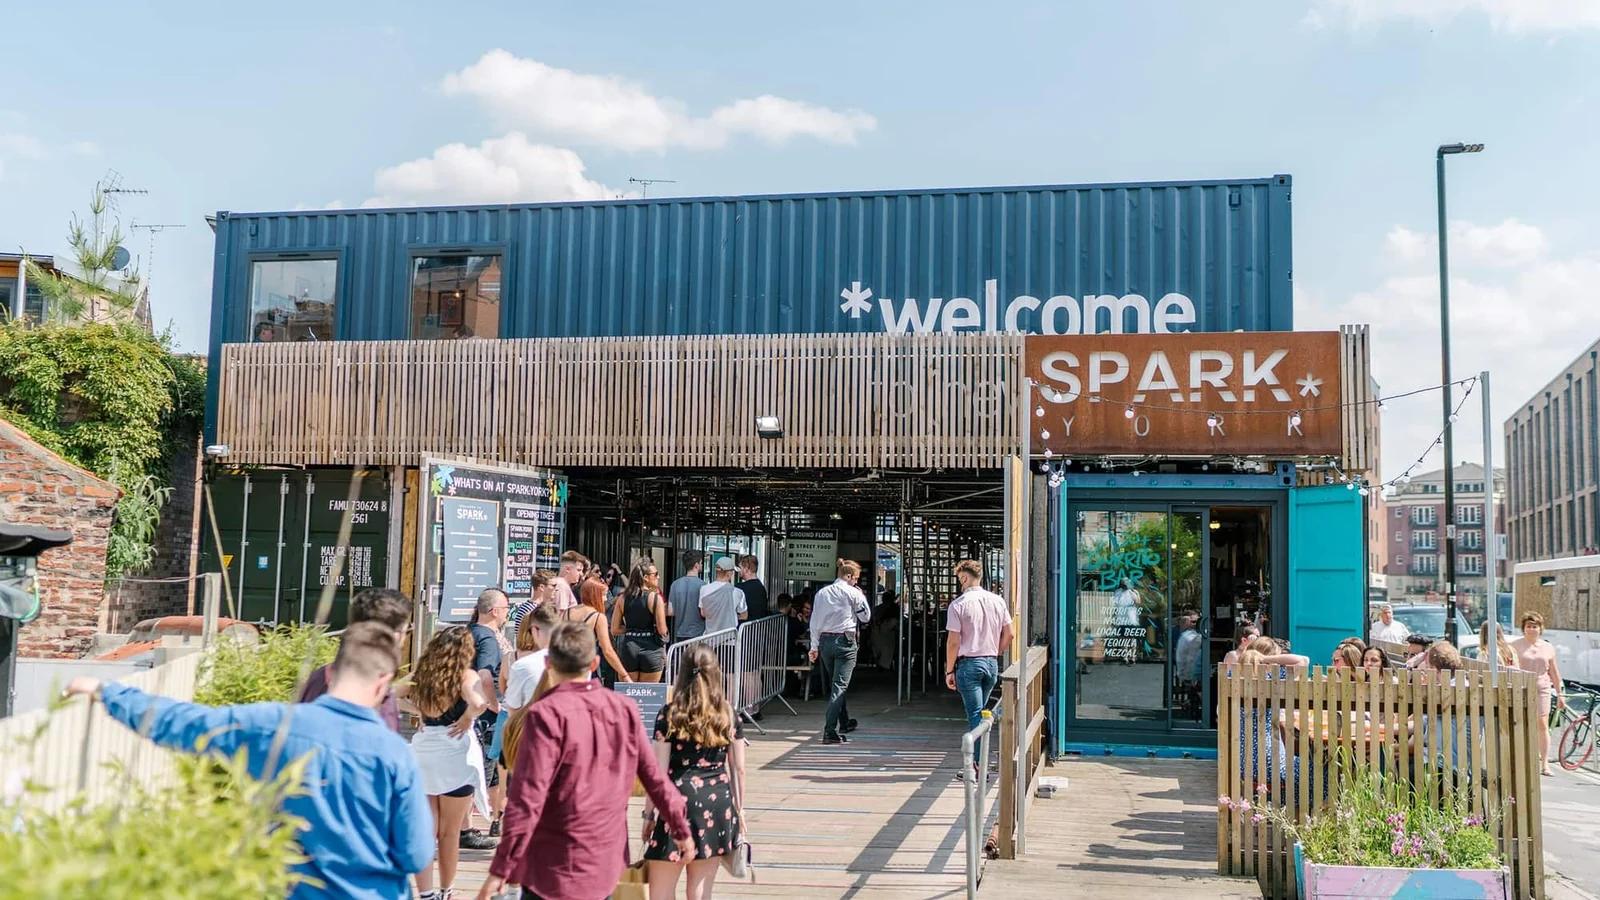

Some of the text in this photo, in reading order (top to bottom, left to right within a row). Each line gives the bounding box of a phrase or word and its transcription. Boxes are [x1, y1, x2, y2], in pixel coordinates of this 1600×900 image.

[878, 279, 1196, 334] welcome
[1040, 350, 1293, 404] SPARK
[453, 476, 481, 490] WHAT'S
[483, 481, 494, 491] ON
[496, 482, 505, 493] AT
[329, 499, 349, 511] FAMU
[351, 500, 379, 511] 730624
[457, 508, 484, 521] SPARK
[516, 509, 540, 519] OPENING
[1099, 568, 1144, 591] BAR
[1096, 627, 1147, 637] LOCAL BEER
[1103, 638, 1138, 648] TEQUILA
[1103, 648, 1138, 658] MEZCAL
[625, 688, 652, 697] SPARK
